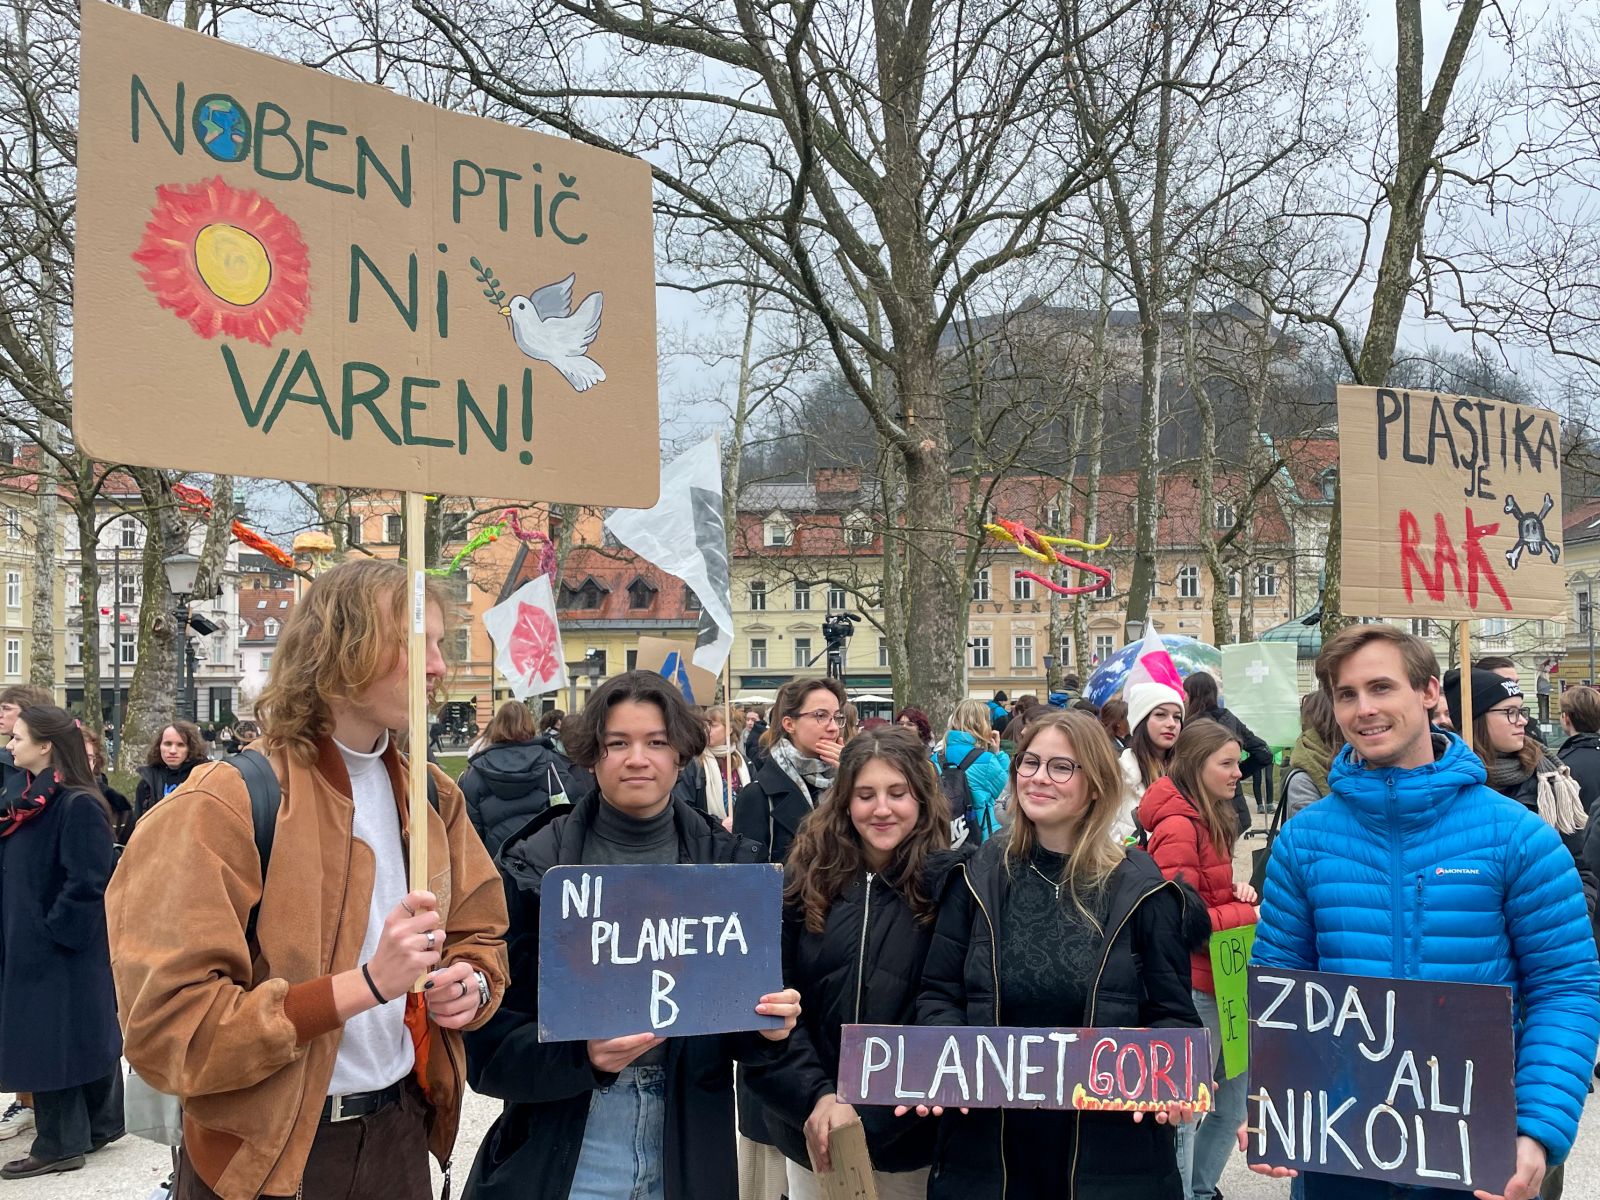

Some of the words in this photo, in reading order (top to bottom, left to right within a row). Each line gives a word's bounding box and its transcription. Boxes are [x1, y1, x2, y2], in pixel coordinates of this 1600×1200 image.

[131, 73, 412, 209] NOBEN
[220, 343, 534, 466] VAREN!
[1376, 388, 1559, 473] PLASTIKA
[1463, 464, 1497, 500] JE
[1398, 506, 1513, 611] RAK
[562, 873, 602, 919] NI
[591, 912, 748, 965] PLANETA
[650, 969, 680, 1029] B
[1257, 976, 1396, 1061] ZDAJ
[860, 1031, 1080, 1105] PLANET
[1088, 1036, 1194, 1101] GORI
[1385, 1050, 1474, 1115] ALI
[1257, 1086, 1473, 1185] NIKOLI
